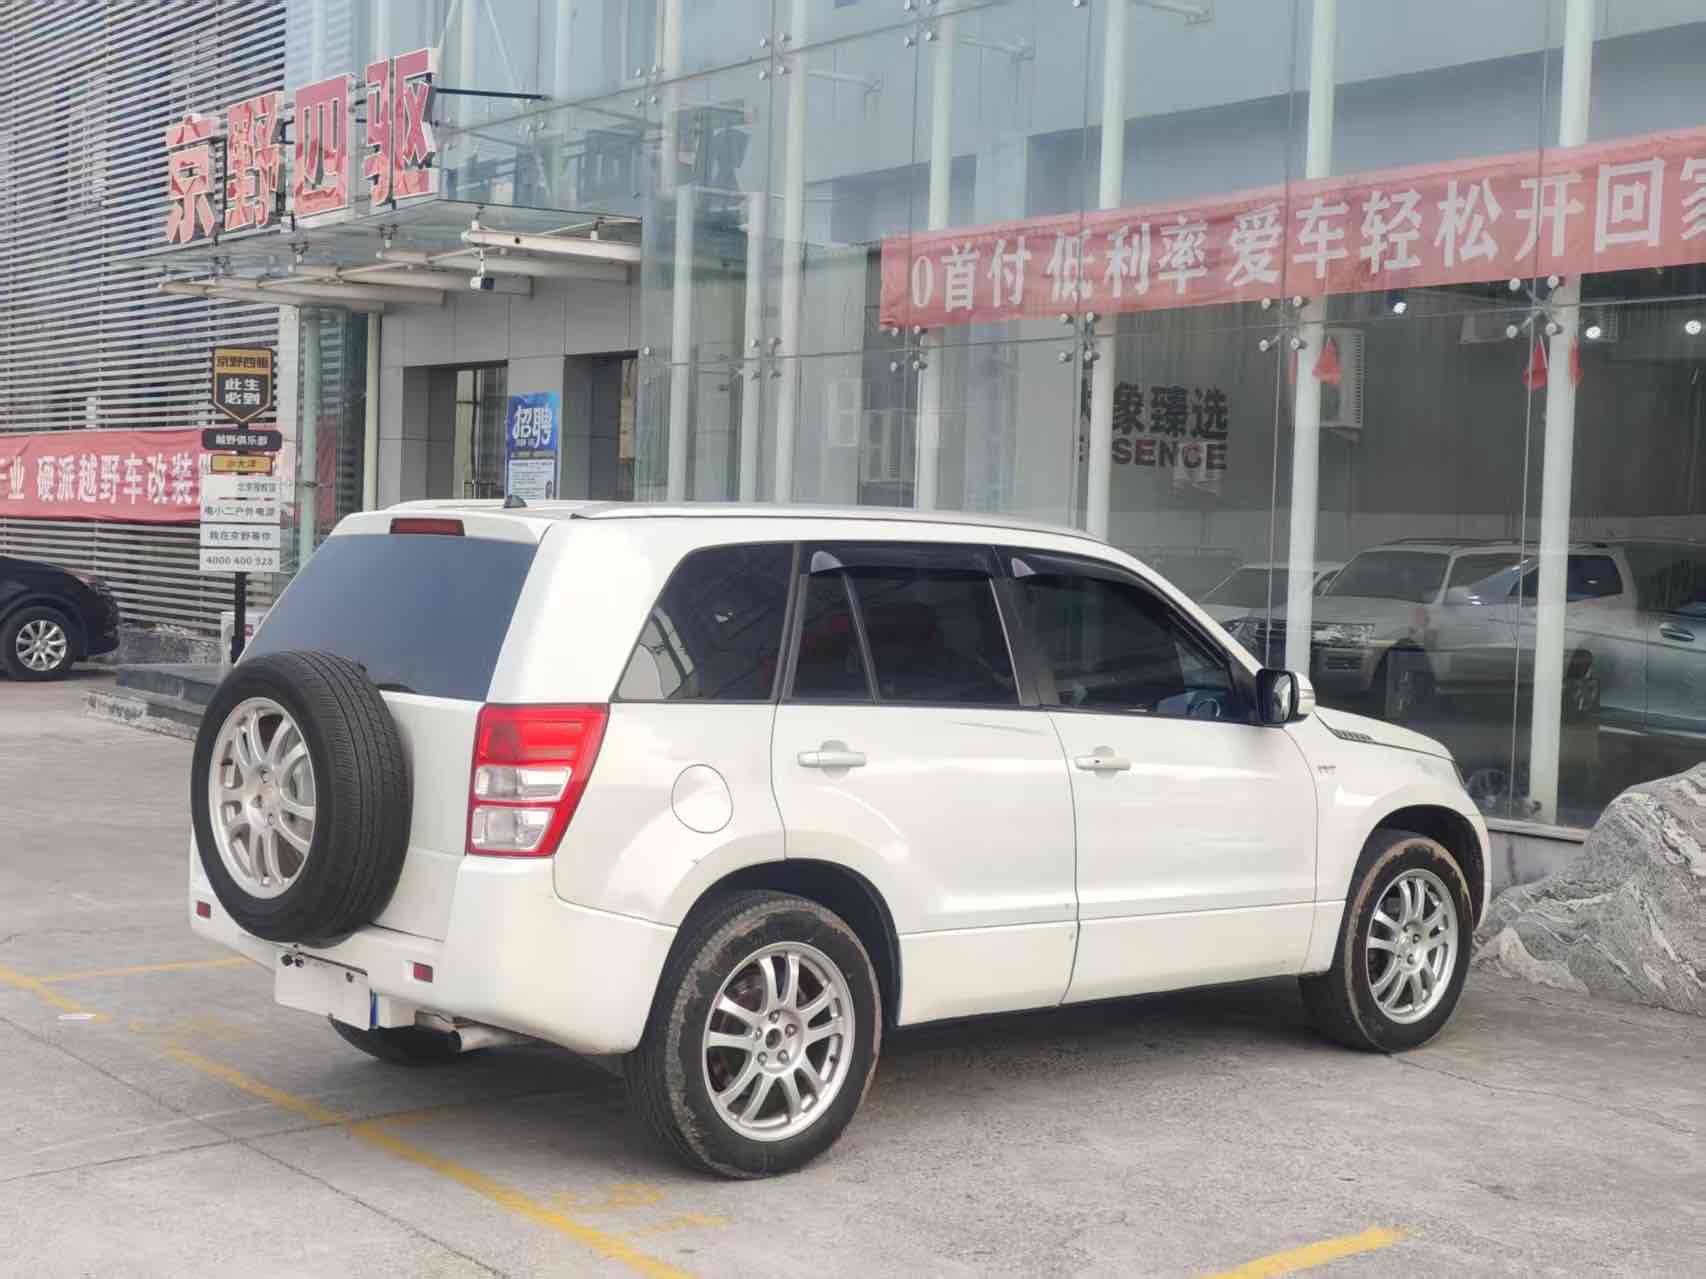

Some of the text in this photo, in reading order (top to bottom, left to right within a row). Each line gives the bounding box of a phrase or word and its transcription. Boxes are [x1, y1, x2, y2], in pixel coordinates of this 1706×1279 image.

[166, 49, 436, 245] 京野四驱
[224, 378, 260, 391] 此生
[224, 392, 260, 405] 必到
[512, 403, 553, 449] 招聘
